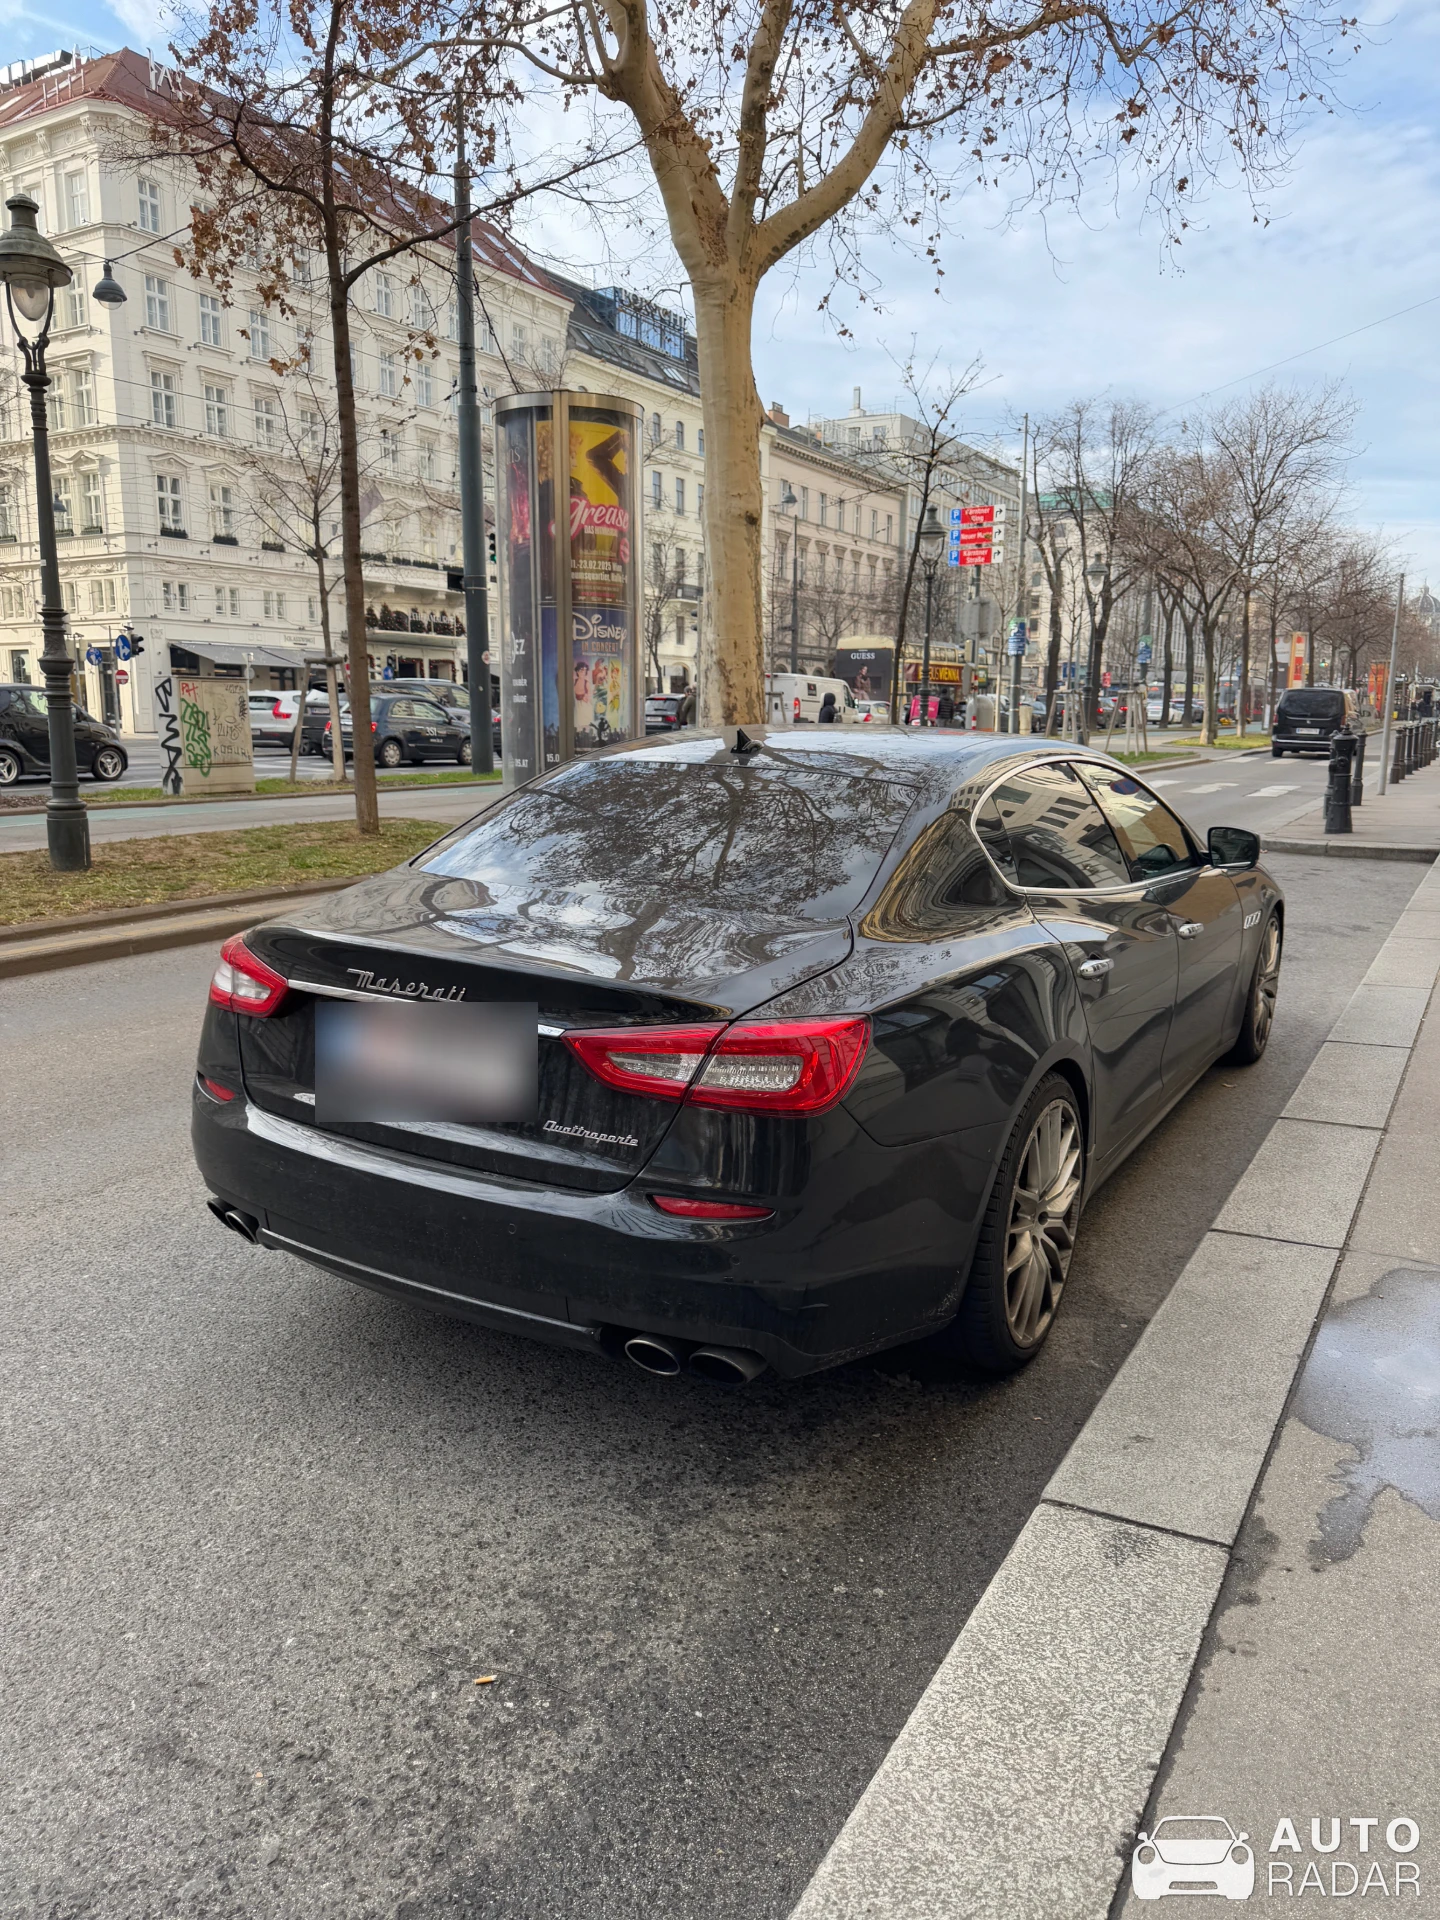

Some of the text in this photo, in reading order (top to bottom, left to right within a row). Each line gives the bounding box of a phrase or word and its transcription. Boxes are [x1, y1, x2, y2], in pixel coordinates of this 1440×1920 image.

[850, 652, 876, 660] GUESS
[546, 753, 560, 763] 15.0
[347, 968, 466, 1002] Maserati
[543, 1120, 639, 1147] Quattroporte
